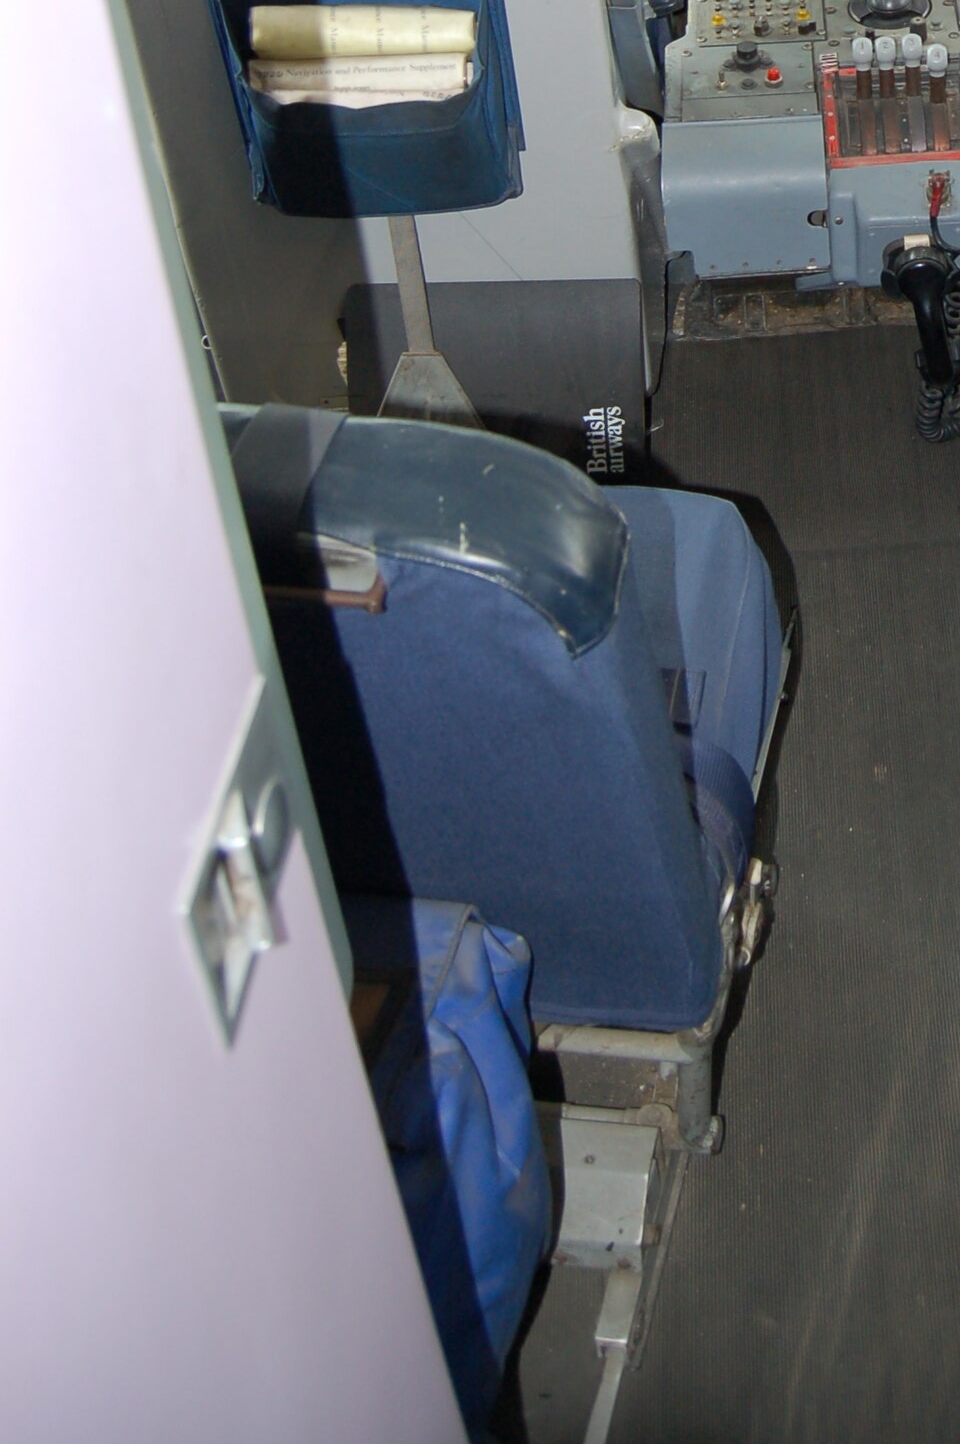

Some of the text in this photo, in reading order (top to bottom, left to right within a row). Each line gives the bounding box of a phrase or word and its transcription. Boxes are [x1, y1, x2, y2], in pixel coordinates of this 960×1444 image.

[286, 66, 333, 77] Navigation
[335, 62, 351, 75] and
[353, 61, 406, 74] Performance
[409, 58, 456, 72] Supplement
[583, 407, 608, 474] British
[606, 405, 626, 473] airways
